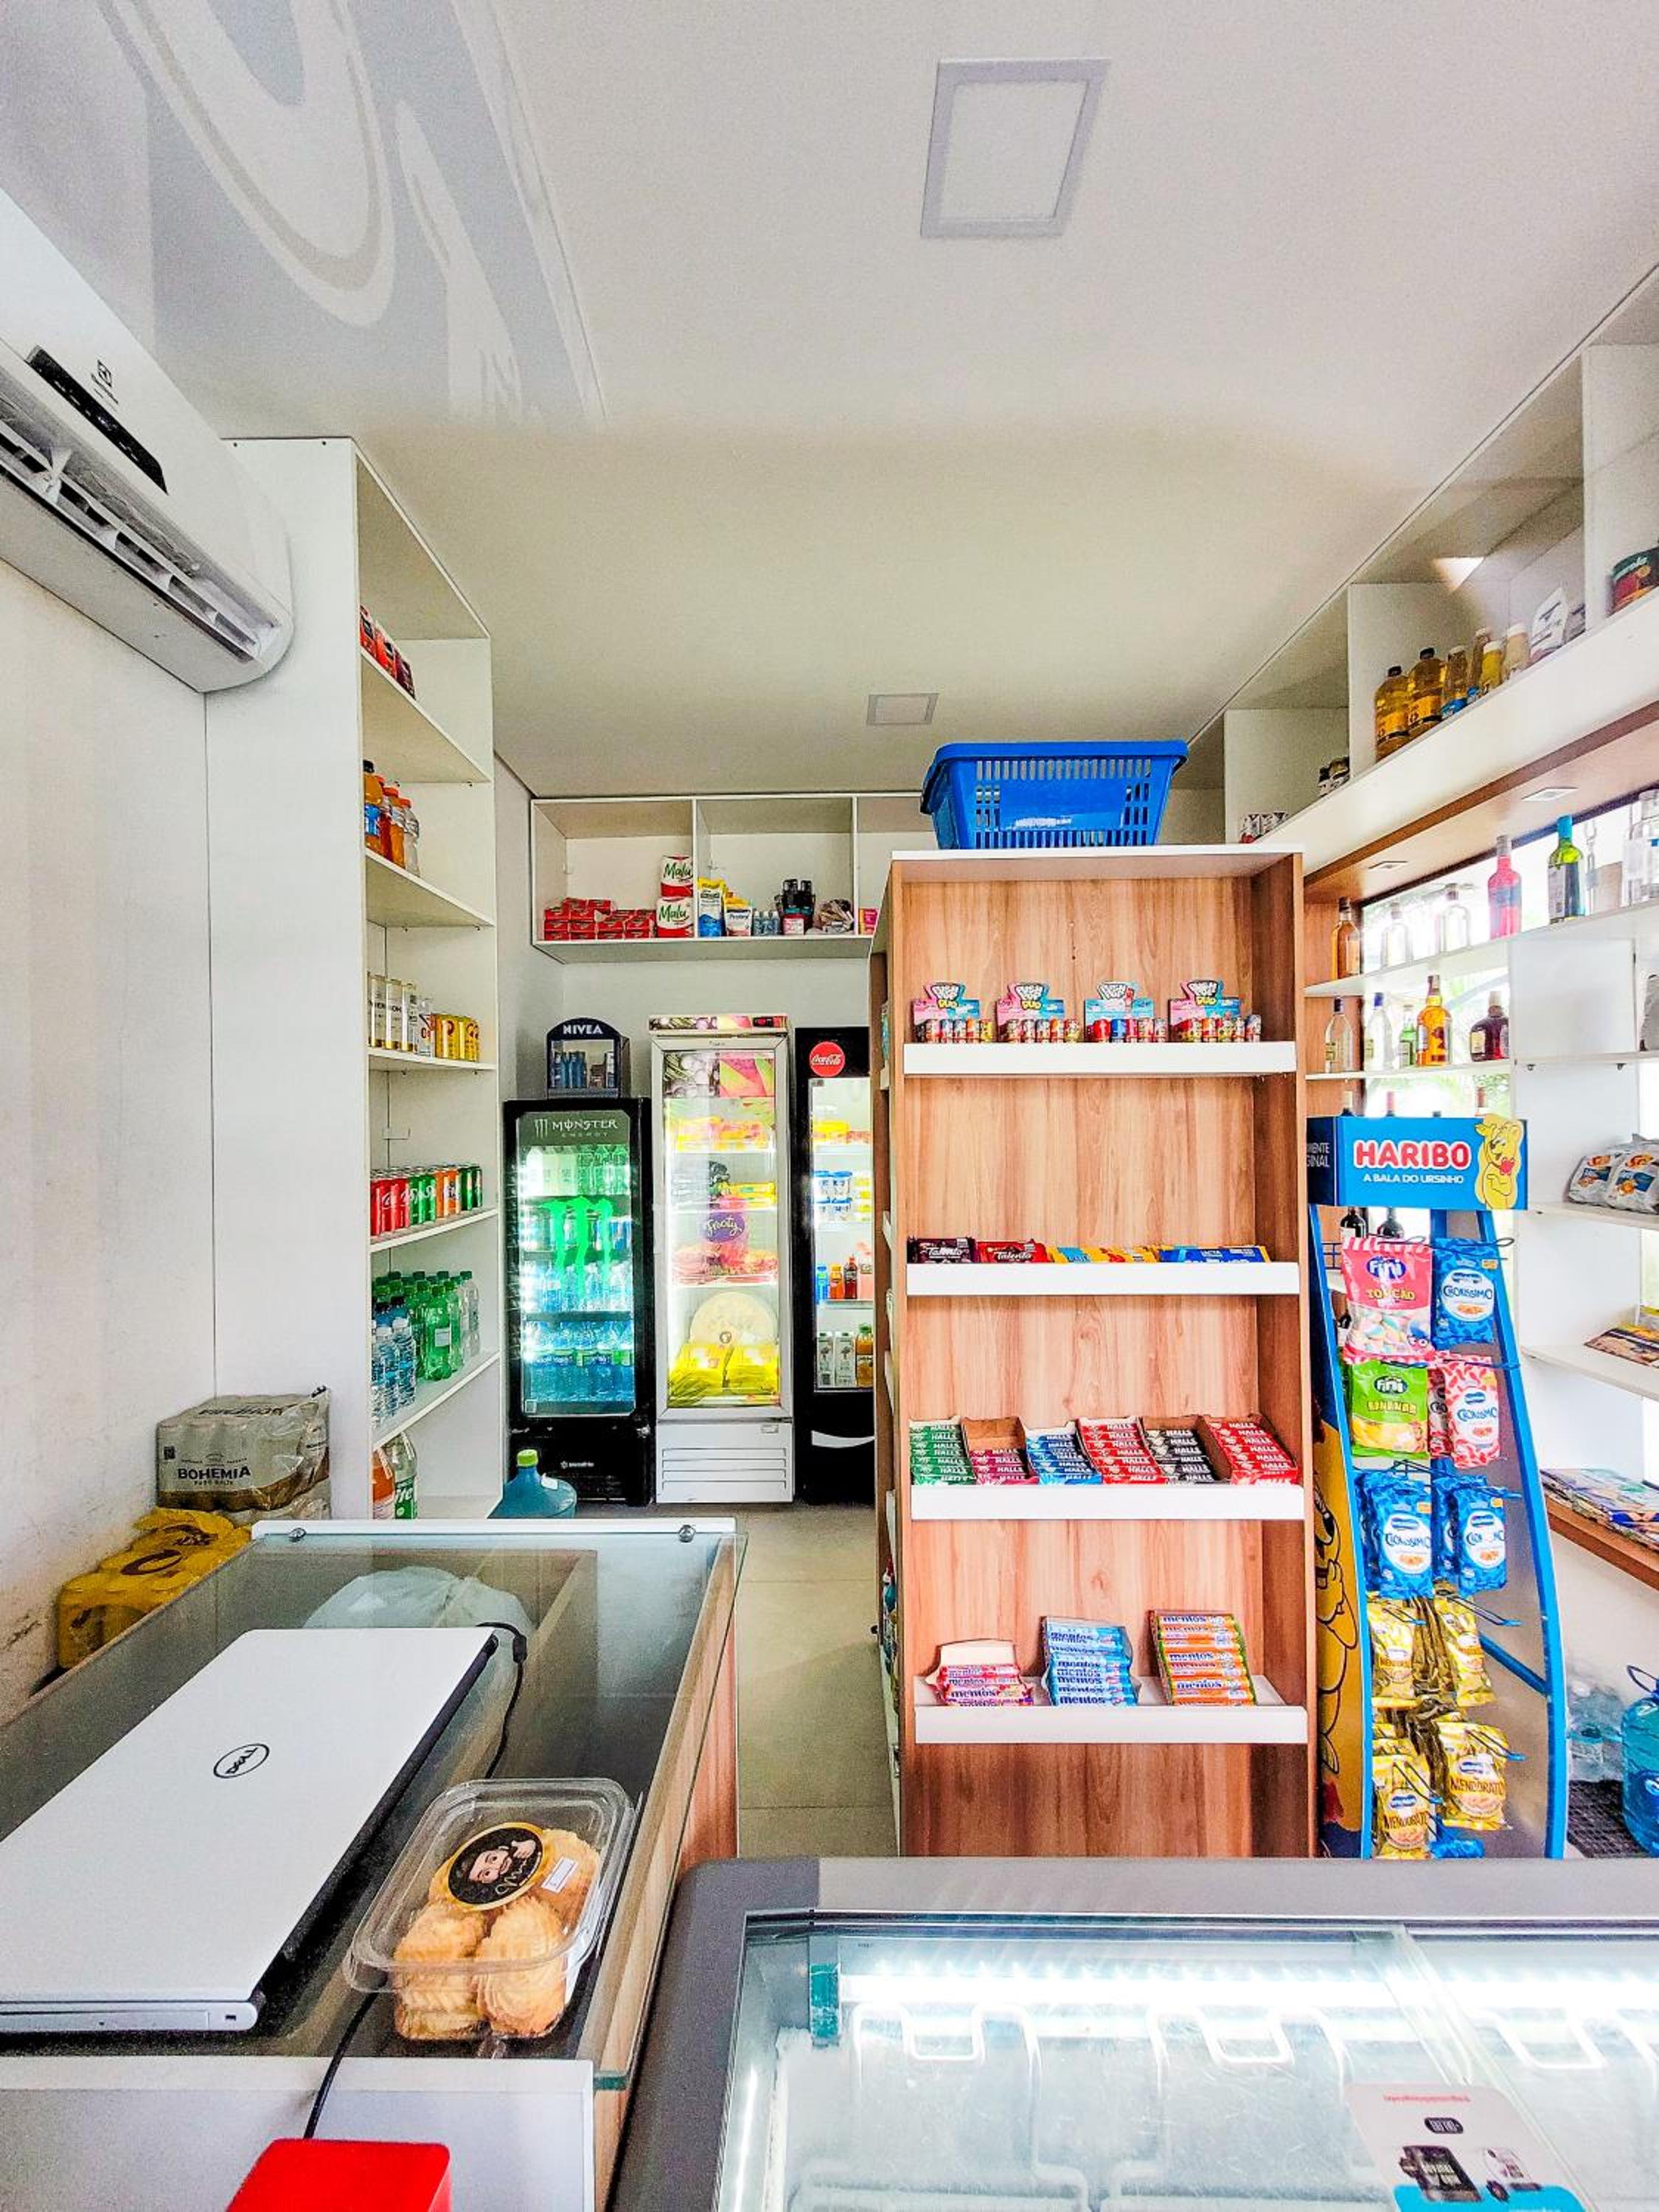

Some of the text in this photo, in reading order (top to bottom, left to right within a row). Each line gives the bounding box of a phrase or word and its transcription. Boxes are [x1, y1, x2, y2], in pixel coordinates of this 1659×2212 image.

[664, 862, 692, 879] Malu
[658, 904, 687, 922] Malu
[563, 1024, 603, 1034] NIVEA
[553, 1119, 618, 1132] MONSTER
[1354, 1140, 1472, 1170] HARIBO
[1363, 1173, 1464, 1183] A BALA DO URSINHO
[178, 1466, 251, 1480] BOHEMIA
[1060, 1696, 1106, 1704] mentos
